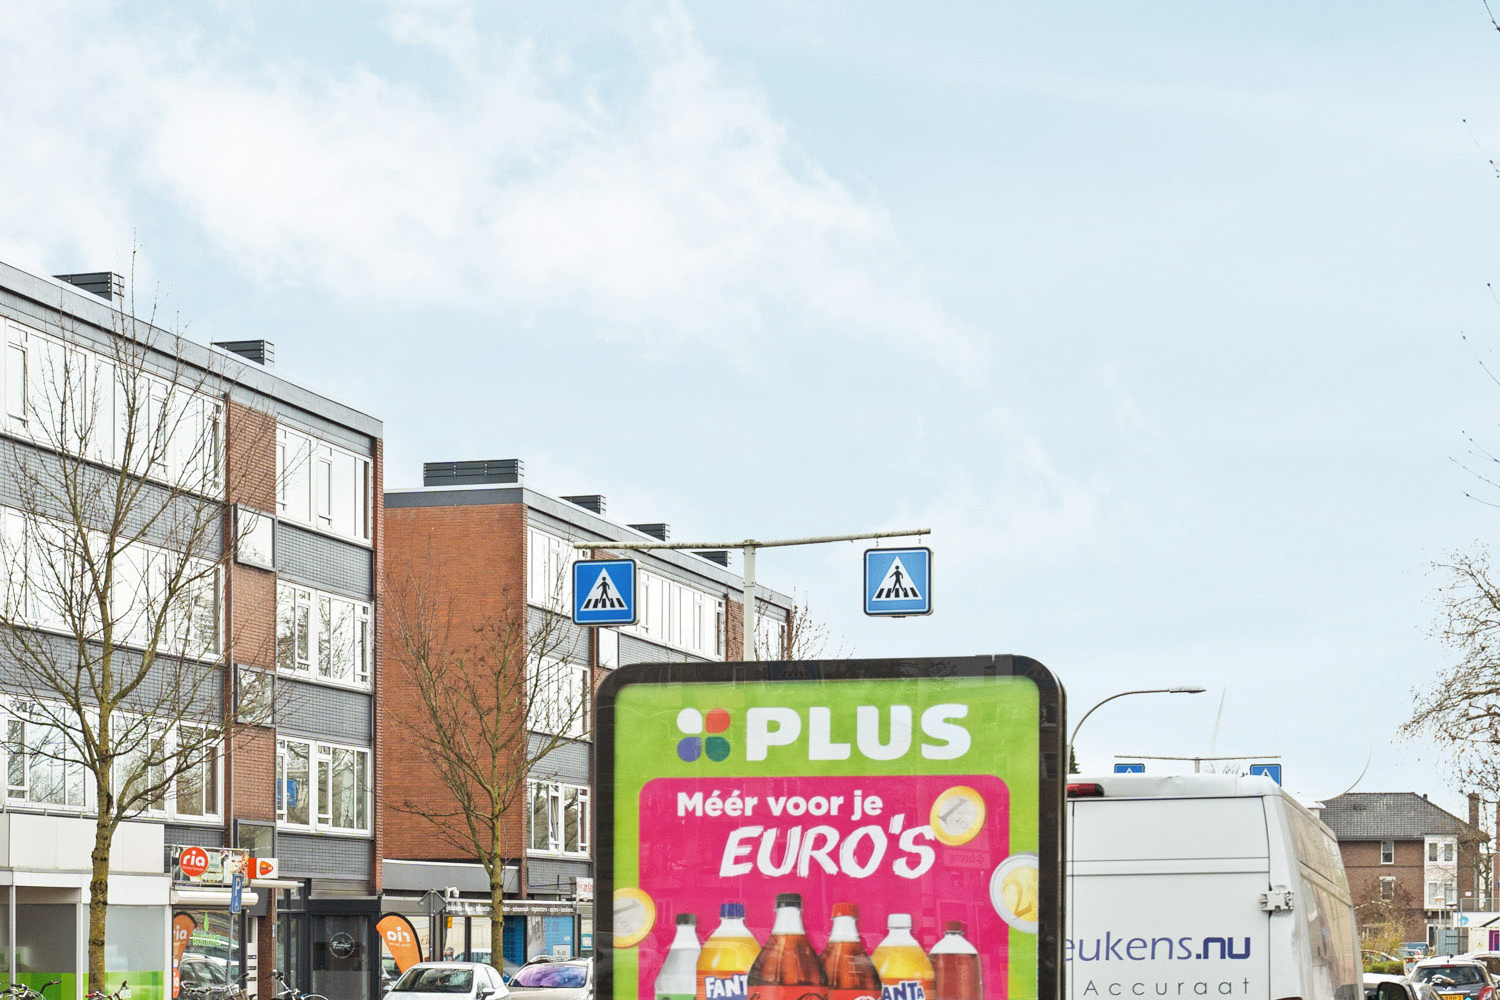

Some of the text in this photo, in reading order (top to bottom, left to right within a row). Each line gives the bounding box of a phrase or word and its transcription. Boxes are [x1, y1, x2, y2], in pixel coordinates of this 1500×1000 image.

[746, 704, 972, 762] PLUS
[677, 789, 884, 822] Méér voor je
[183, 850, 206, 867] ria
[719, 813, 937, 879] EURO'S
[235, 877, 241, 897] P
[1083, 977, 1250, 997] Accuraat
